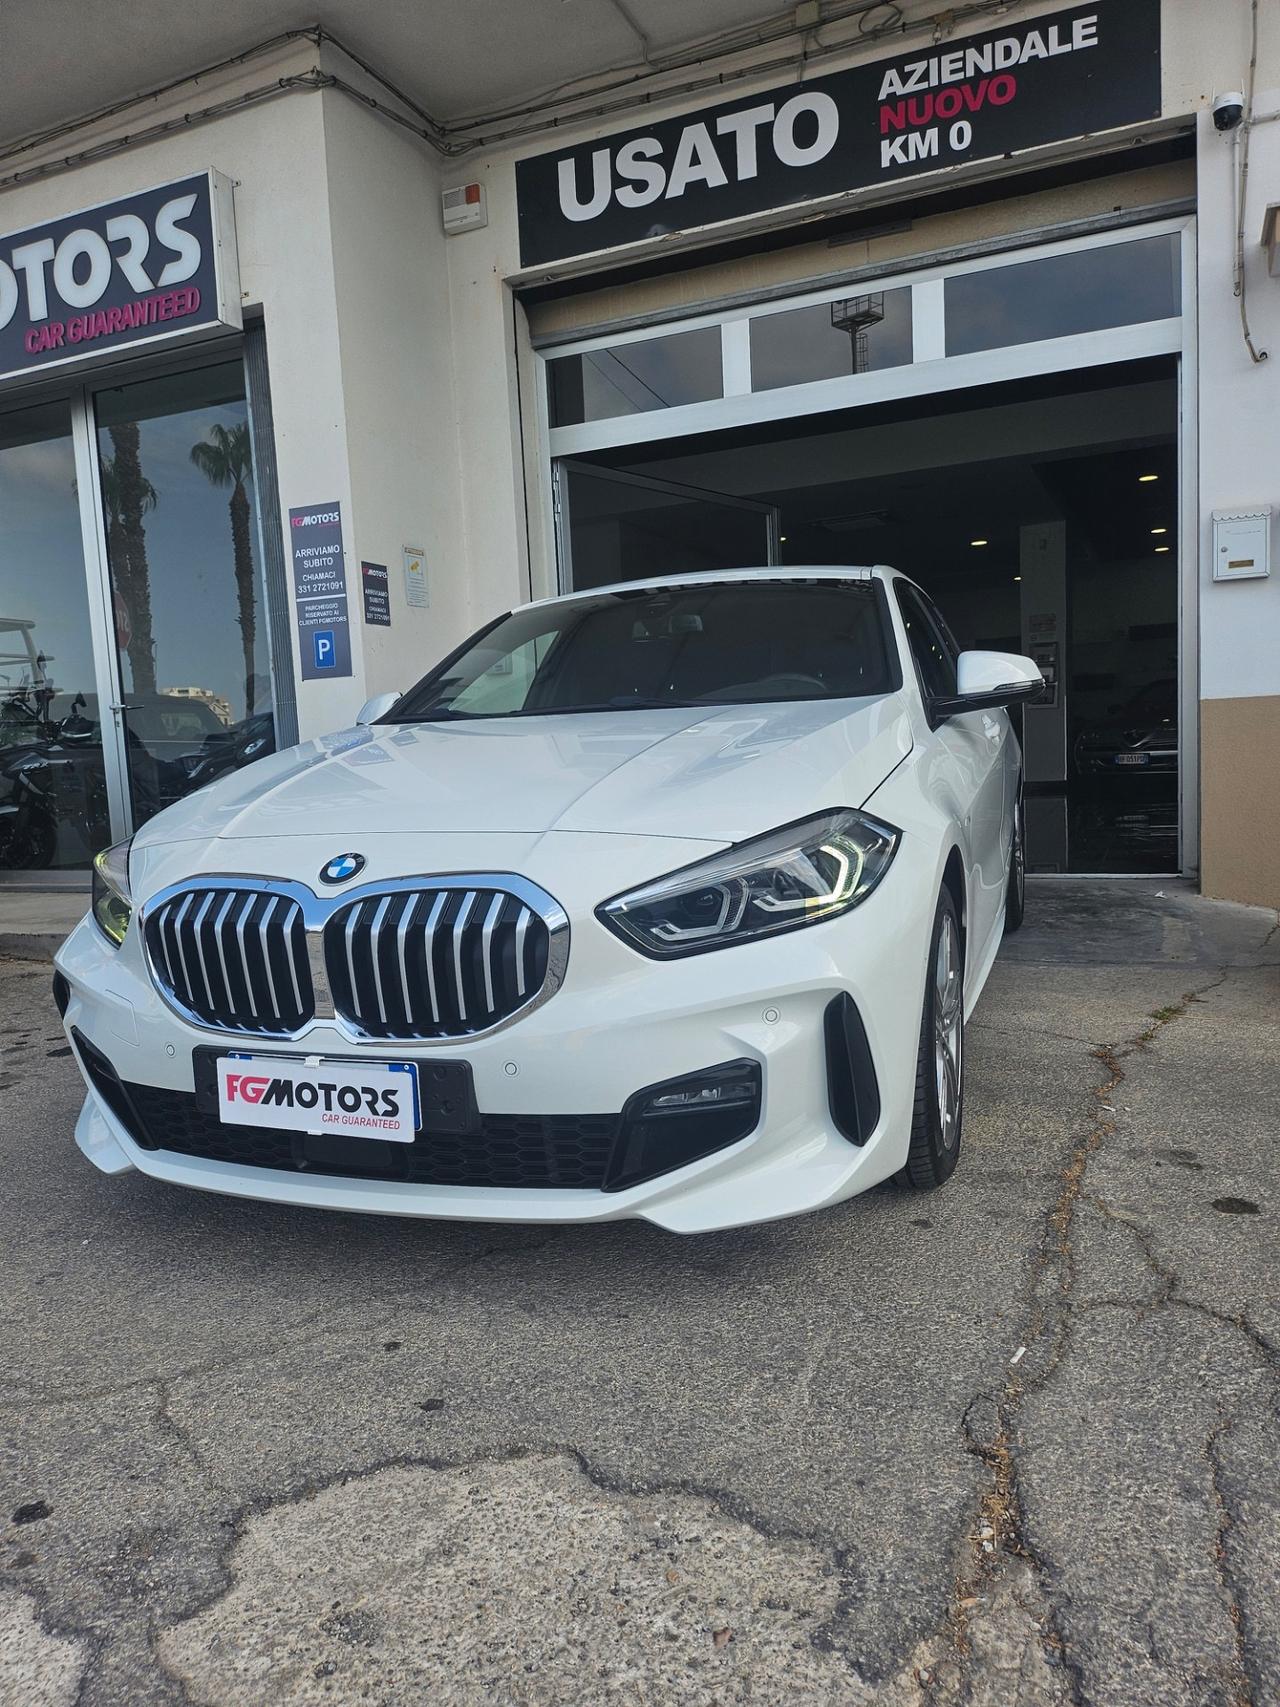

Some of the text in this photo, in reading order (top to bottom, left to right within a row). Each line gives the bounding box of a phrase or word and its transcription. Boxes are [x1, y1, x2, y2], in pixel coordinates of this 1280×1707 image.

[878, 15, 1098, 100] AZIENDALE
[880, 75, 1016, 134] NUOVO
[558, 91, 839, 222] USATO
[881, 120, 972, 168] KM 0
[25, 287, 200, 353] CAR GUARANTEED
[295, 545, 340, 558] ARRIVIAMO
[304, 557, 333, 568] SUBITO
[298, 581, 343, 593] 331 2721091
[303, 571, 335, 581] CHIAMACI
[318, 639, 330, 660] P
[226, 1073, 400, 1118] FGMOTORS
[322, 1113, 400, 1130] CAR GUARANTEED
